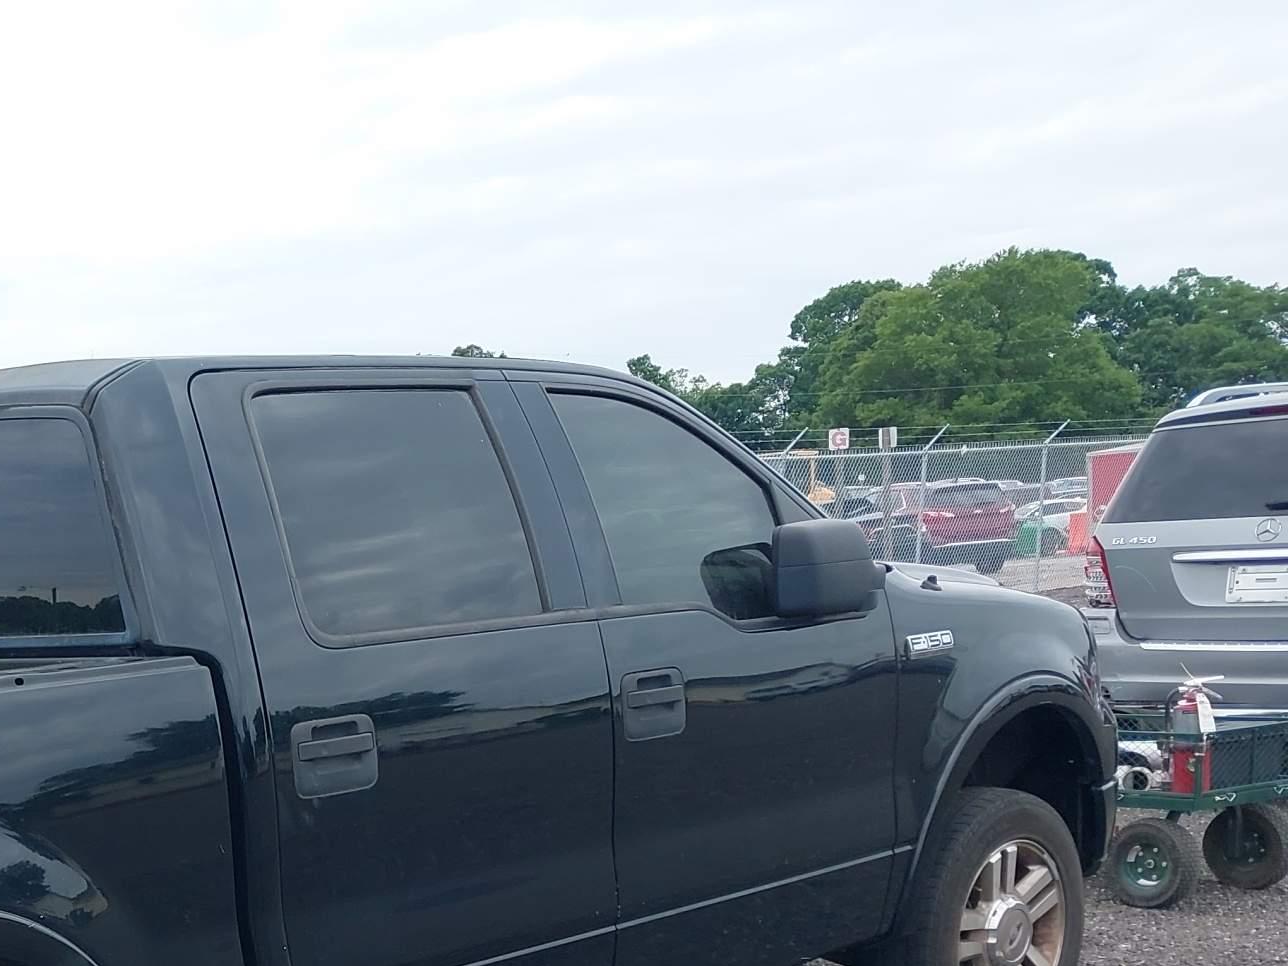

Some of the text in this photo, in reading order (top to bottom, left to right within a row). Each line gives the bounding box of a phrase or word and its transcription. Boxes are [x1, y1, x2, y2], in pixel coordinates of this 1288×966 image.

[831, 431, 847, 447] G
[1111, 536, 1157, 545] GL 450
